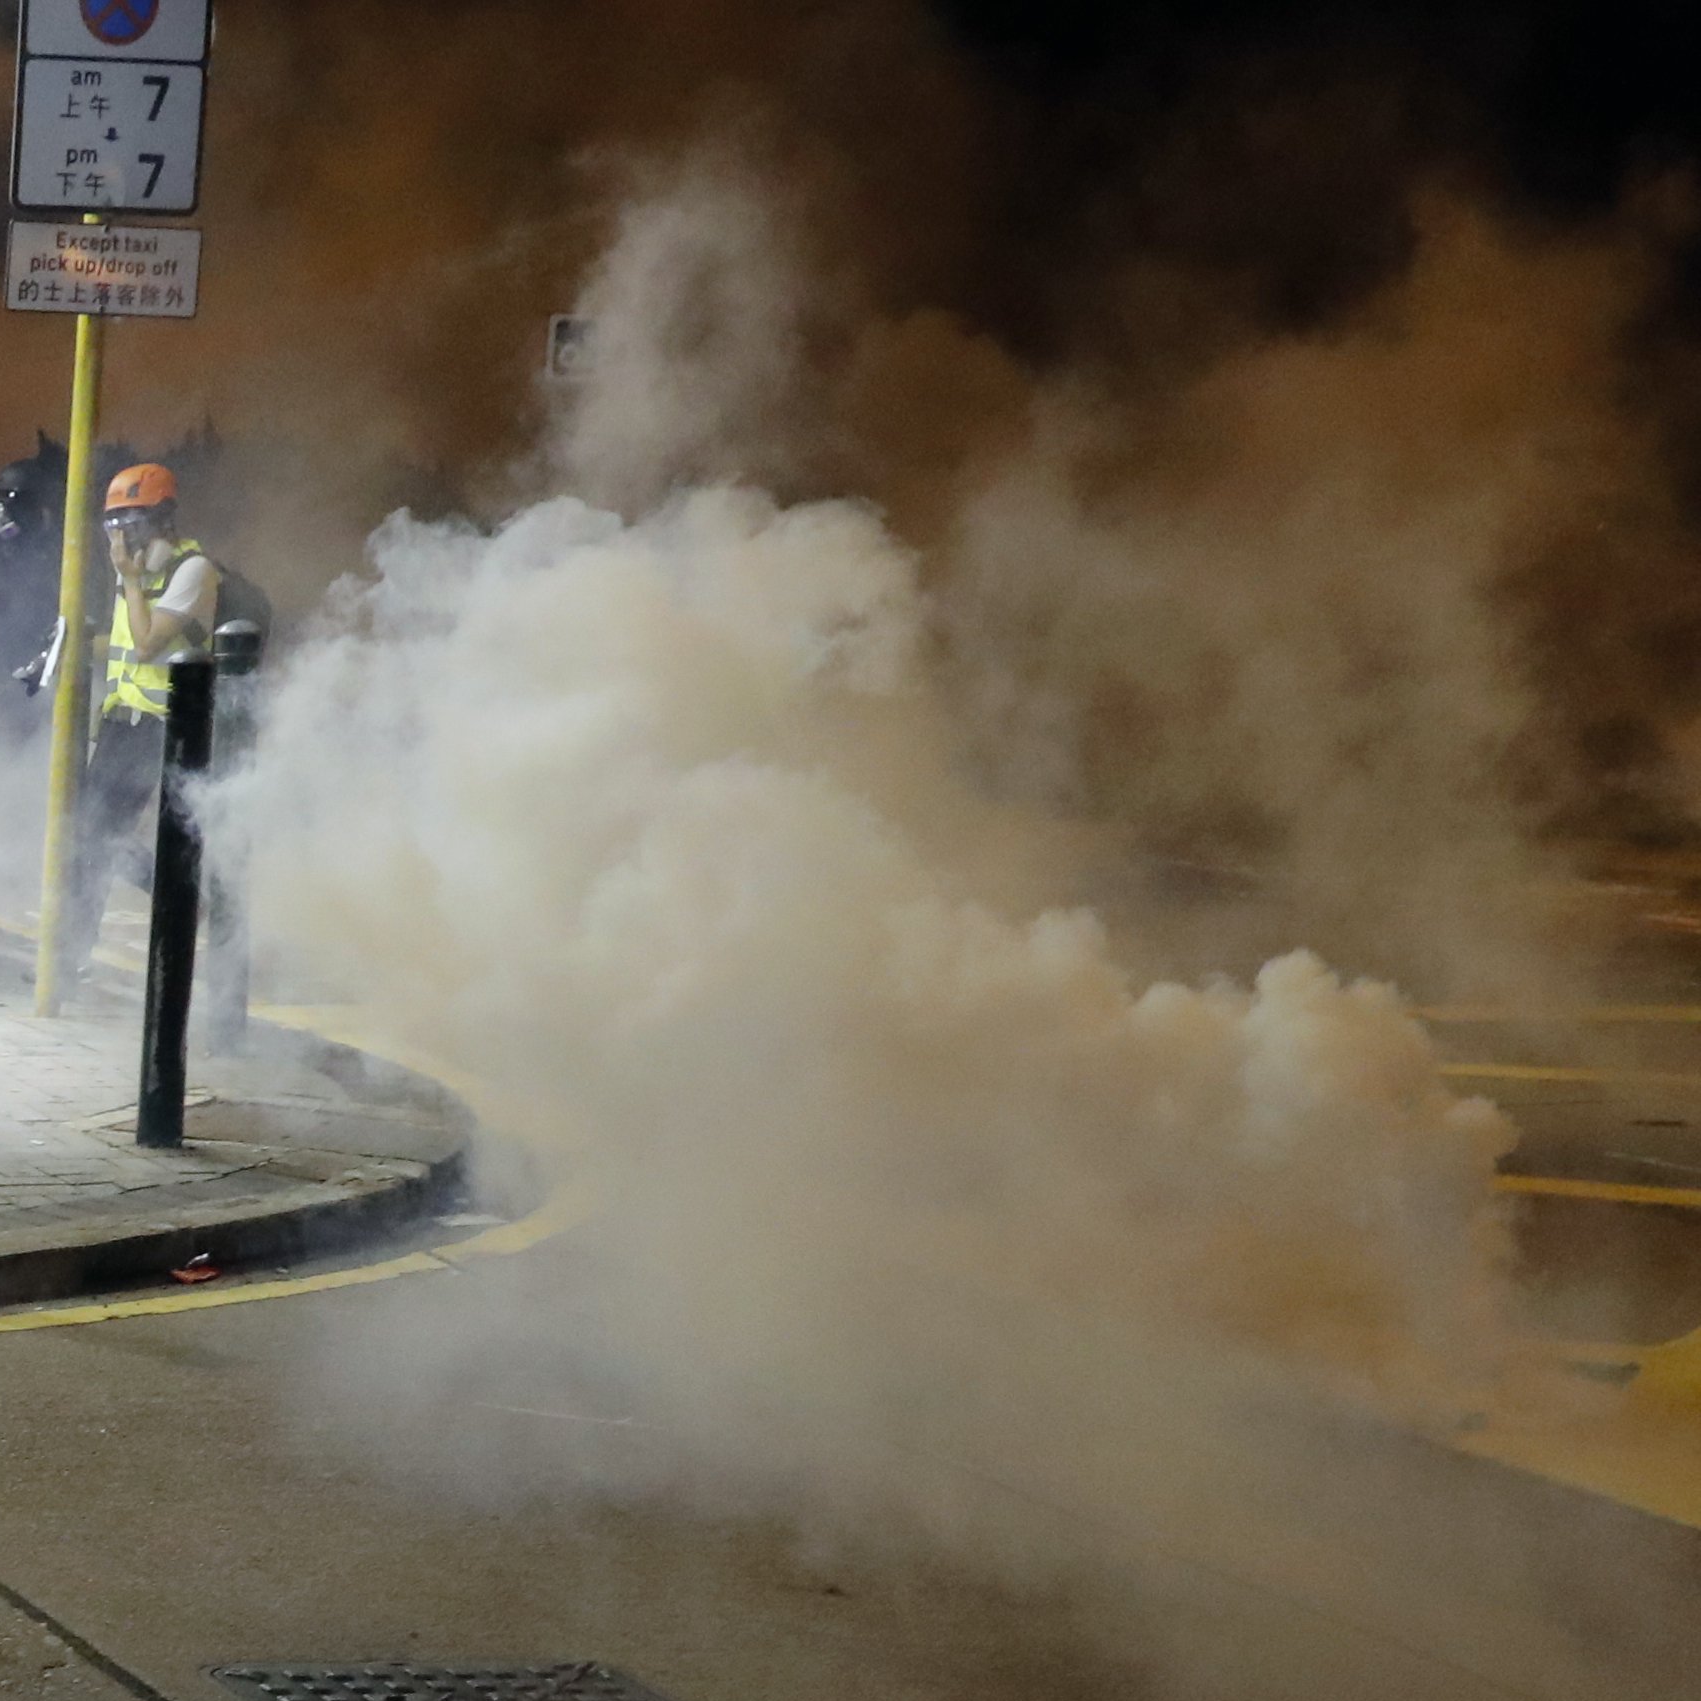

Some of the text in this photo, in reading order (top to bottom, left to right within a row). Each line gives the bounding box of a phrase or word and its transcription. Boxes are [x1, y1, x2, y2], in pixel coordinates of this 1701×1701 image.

[71, 69, 102, 86] am
[59, 93, 110, 119] 上午
[142, 76, 171, 122] 7
[65, 148, 98, 166] pm
[57, 172, 105, 197] 下午
[138, 153, 165, 199] 7
[56, 231, 159, 252] Except taxi
[30, 254, 178, 277] pick up/drop off
